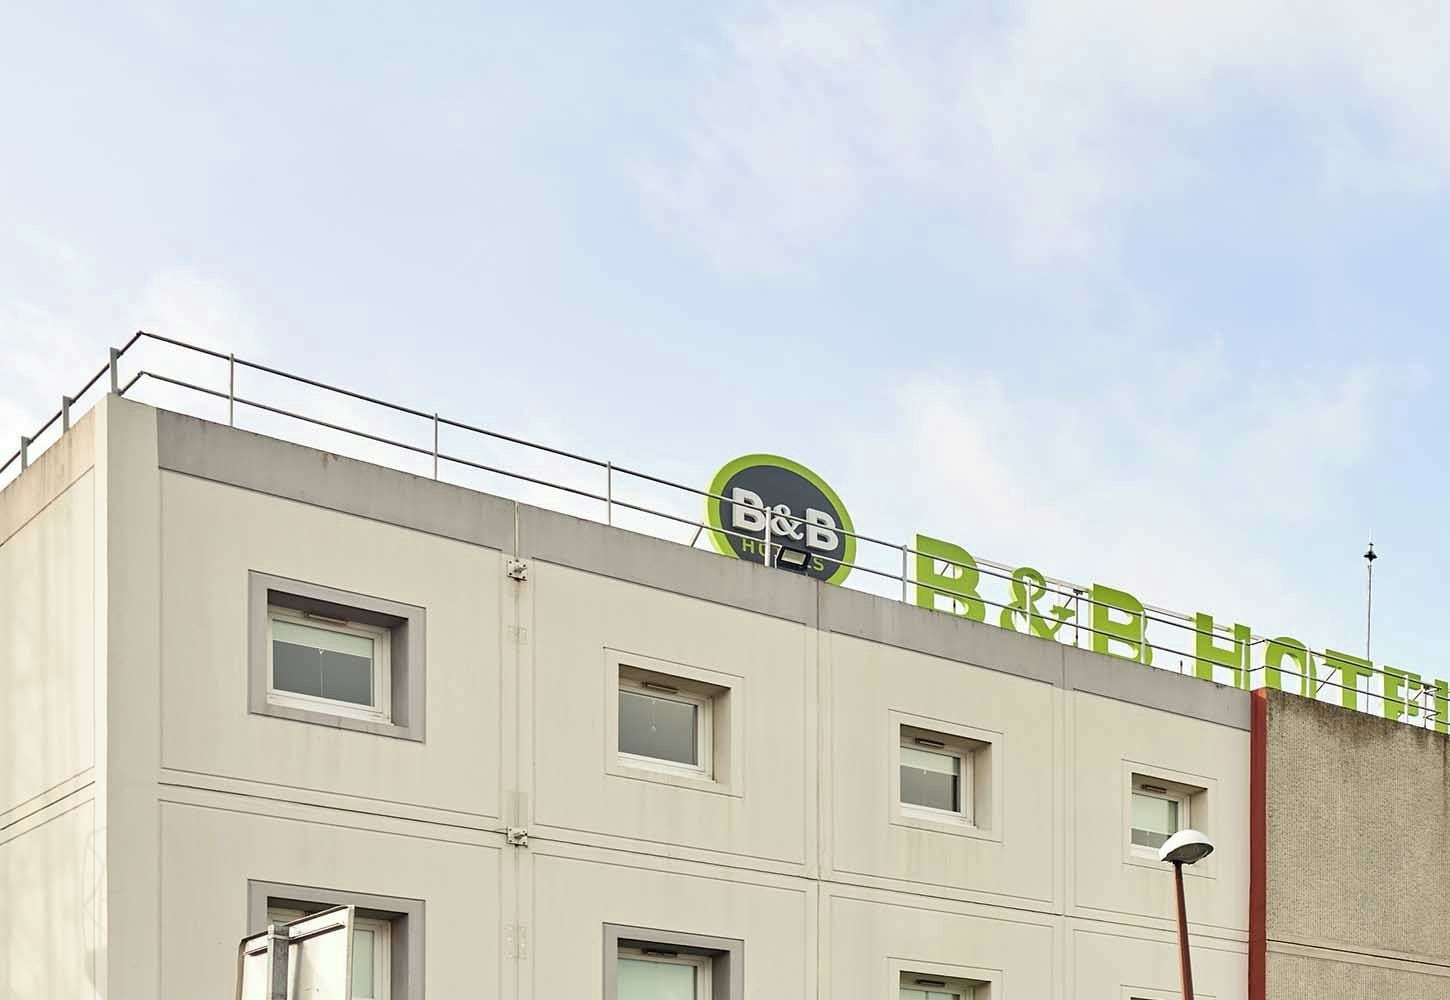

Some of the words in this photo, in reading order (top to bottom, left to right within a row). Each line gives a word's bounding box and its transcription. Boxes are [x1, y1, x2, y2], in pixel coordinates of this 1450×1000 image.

[732, 487, 839, 551] B&B
[742, 538, 825, 572] HOS
[914, 533, 1153, 664] B&B
